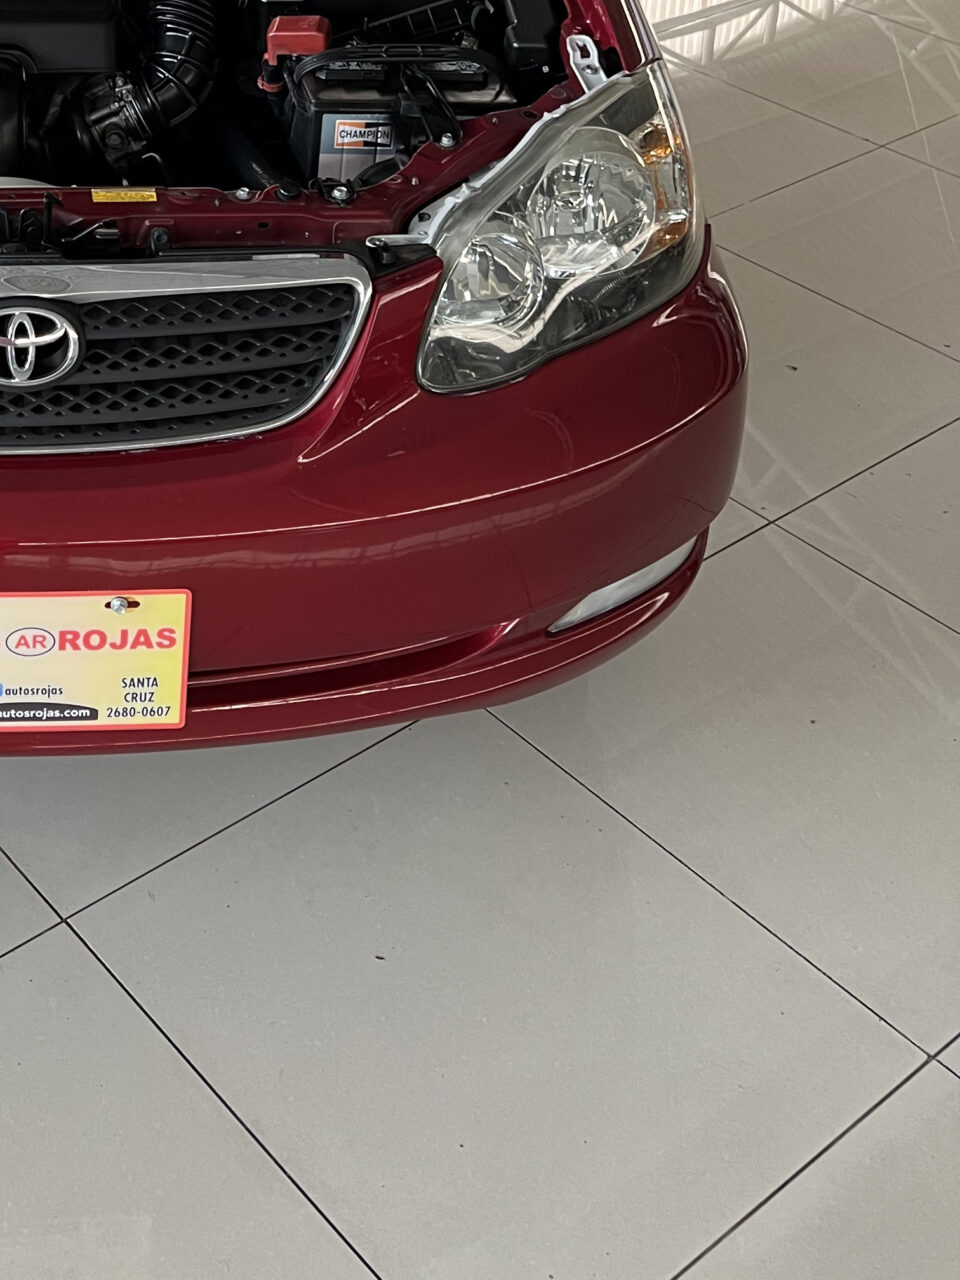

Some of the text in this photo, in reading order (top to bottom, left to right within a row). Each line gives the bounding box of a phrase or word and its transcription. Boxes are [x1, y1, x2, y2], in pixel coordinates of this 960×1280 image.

[339, 129, 390, 139] CHAMPION
[15, 633, 48, 649] AR
[58, 627, 177, 651] ROJAS
[121, 677, 159, 689] SANTA
[4, 684, 64, 698] autosrojas
[123, 691, 155, 703] CRUZ
[106, 705, 172, 718] 2680-0607
